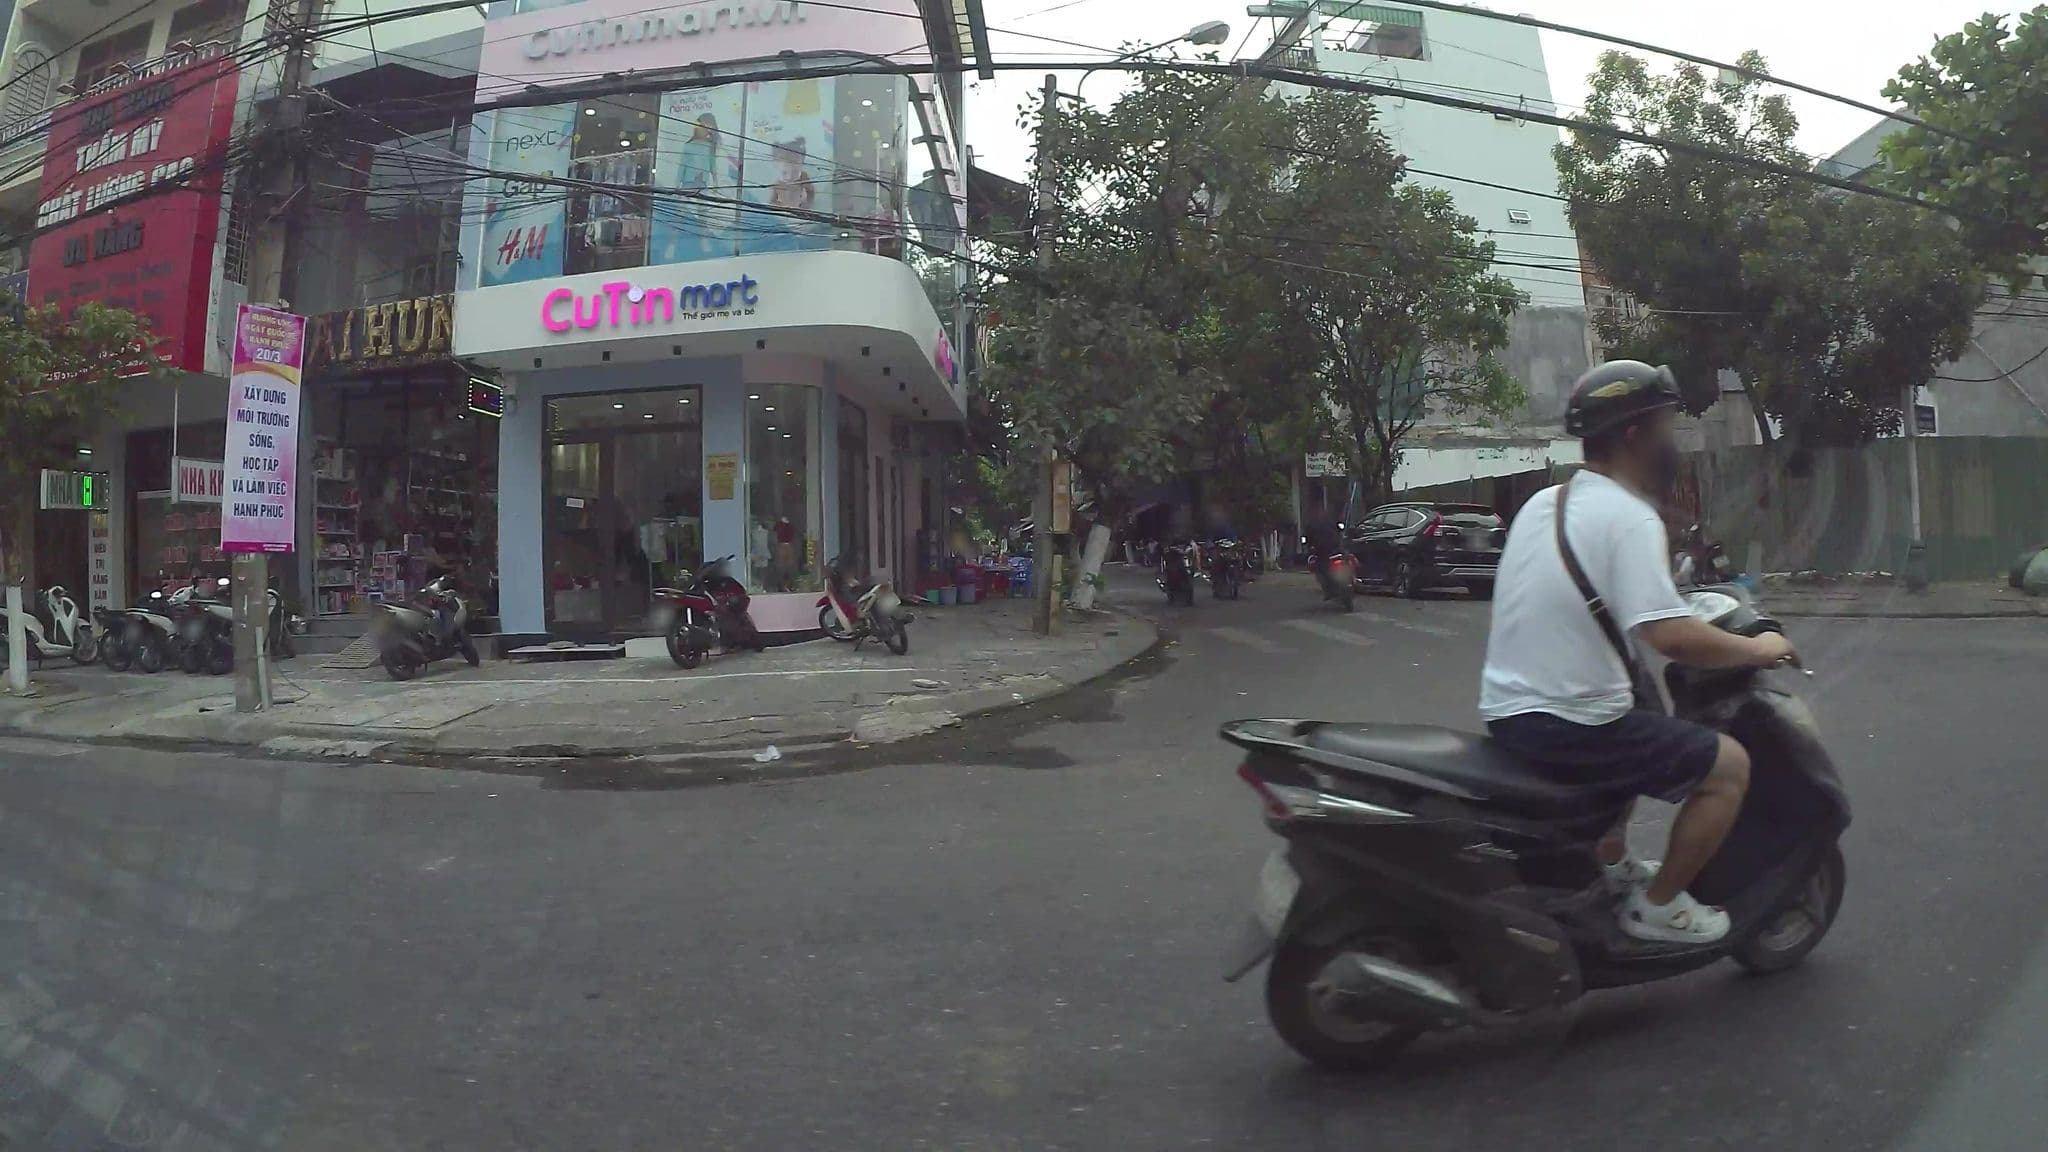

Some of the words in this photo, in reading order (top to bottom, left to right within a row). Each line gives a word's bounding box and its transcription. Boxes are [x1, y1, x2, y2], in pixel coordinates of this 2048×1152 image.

[507, 130, 557, 151] next
[497, 223, 547, 265] H&M
[679, 273, 758, 310] mart
[256, 347, 280, 362] 20/3
[244, 384, 261, 400] XÂY
[263, 388, 287, 405] DỰNG
[243, 456, 260, 473] HỌC
[233, 503, 258, 519] HẠNH
